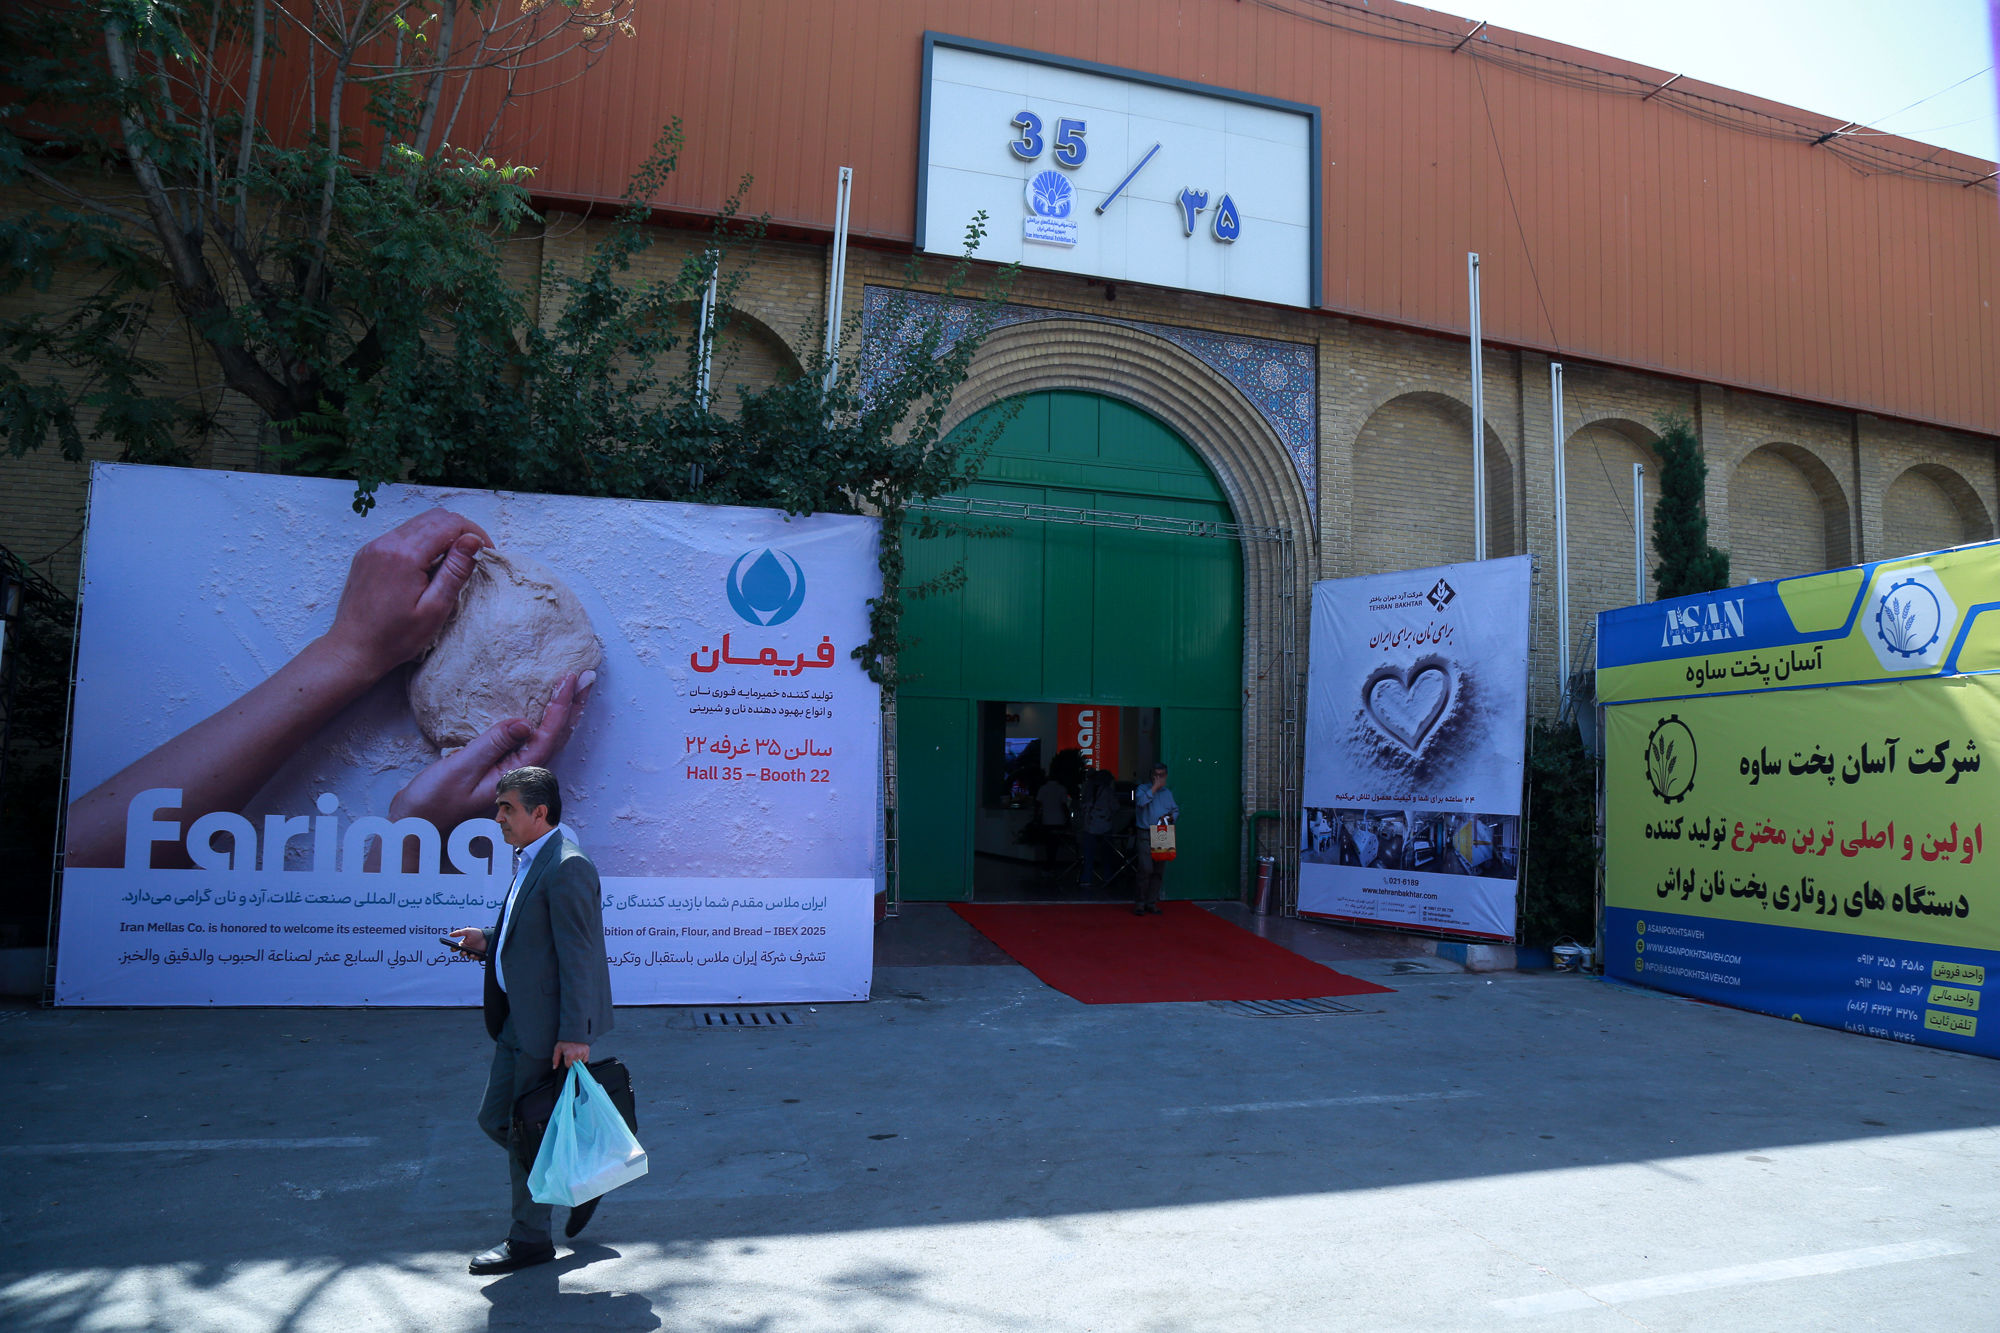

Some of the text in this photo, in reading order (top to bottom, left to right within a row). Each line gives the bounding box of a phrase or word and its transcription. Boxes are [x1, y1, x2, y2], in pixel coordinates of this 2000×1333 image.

[1009, 110, 1088, 169] 35
[1176, 186, 1242, 244] ۳۵
[1398, 592, 1407, 601] آرد
[1369, 600, 1422, 612] TEHRAN BAKHTAR
[1661, 598, 1744, 648] ASAN
[1670, 622, 1730, 636] POKHT SAVEH
[1370, 631, 1392, 651] ایران
[1392, 627, 1412, 649] برای
[1432, 623, 1454, 646] برای
[690, 632, 835, 676] فریمان
[1686, 645, 1823, 688] آسان پخت ساوه
[690, 686, 834, 702] تولید کننده خمیرمایه فوری نان
[690, 704, 832, 718] و انواع بهبود دهنده نان و شیرینی
[686, 734, 832, 760] سالن ۳۵ غرفه ۲۲
[1740, 738, 1980, 786] شرکت آسان پخت ساوه
[686, 766, 718, 780] Hall
[722, 767, 742, 780] 35
[760, 768, 806, 782] Booth
[810, 769, 830, 782] 22
[1356, 793, 1370, 802] تلاش
[1372, 793, 1392, 802] محصول
[1418, 794, 1428, 802] شما
[1430, 794, 1444, 804] برای
[1645, 816, 1982, 864] اولین و اصلی ترین مخترع تولید کننده
[174, 888, 212, 906] گرامی
[214, 890, 236, 905] نان
[238, 895, 246, 906] و
[304, 894, 352, 904] صنعت
[354, 892, 396, 908] المللی
[424, 892, 484, 908] نمایشگاه
[1362, 887, 1438, 900] www.tehranbakhtar.com
[1656, 868, 1970, 918] دستگاه های روتاری پخت نان لواش
[398, 897, 422, 908] بین
[616, 894, 666, 910] کنندگان
[668, 896, 702, 911] بازدید
[704, 896, 729, 908] شما
[732, 897, 764, 912] مقدم
[766, 896, 799, 910] ملاس
[802, 896, 826, 911] ایران
[120, 922, 144, 932] Iran
[148, 922, 184, 932] Mellas
[187, 922, 206, 933] Co.
[208, 922, 218, 932] is
[220, 923, 267, 933] honored
[270, 924, 282, 933] to
[284, 924, 334, 934] welcome
[336, 924, 350, 934] its
[352, 925, 406, 934] esteemed
[409, 925, 448, 935] visitors
[636, 926, 647, 936] of
[648, 926, 679, 938] Grain,
[682, 926, 710, 938] Flour,
[712, 926, 730, 936] and
[733, 927, 762, 936] Bread
[774, 926, 798, 936] IBEX
[800, 926, 826, 936] 2025
[1648, 924, 1705, 939] ASANPOKHTSAVEH
[118, 948, 160, 964] والخبز.
[164, 948, 214, 965] والدقيق
[218, 948, 264, 965] الحبوب
[268, 949, 312, 962] لصناعة
[314, 951, 340, 966] عشر
[344, 949, 384, 966] السابع
[644, 950, 694, 966] باستقبال
[697, 951, 730, 967] ملاس
[790, 949, 826, 965] تتشرف
[1646, 943, 1742, 964] WWW.ASANPOKHTSAVEH.COM
[1857, 954, 1924, 972] ۰۹۱۲ ۳۵۵ ۴۵۸۰
[1645, 962, 1740, 986] INFO@ASANPOKHTSAVEH.COM
[1934, 964, 1983, 983] واحد فروش
[1856, 977, 1923, 996] ۰۹۱۲ ۱۵۵ ۵۰۴۷
[1933, 990, 1974, 1007] واحد مالی
[1929, 1014, 1972, 1031] تلفن ثابت
